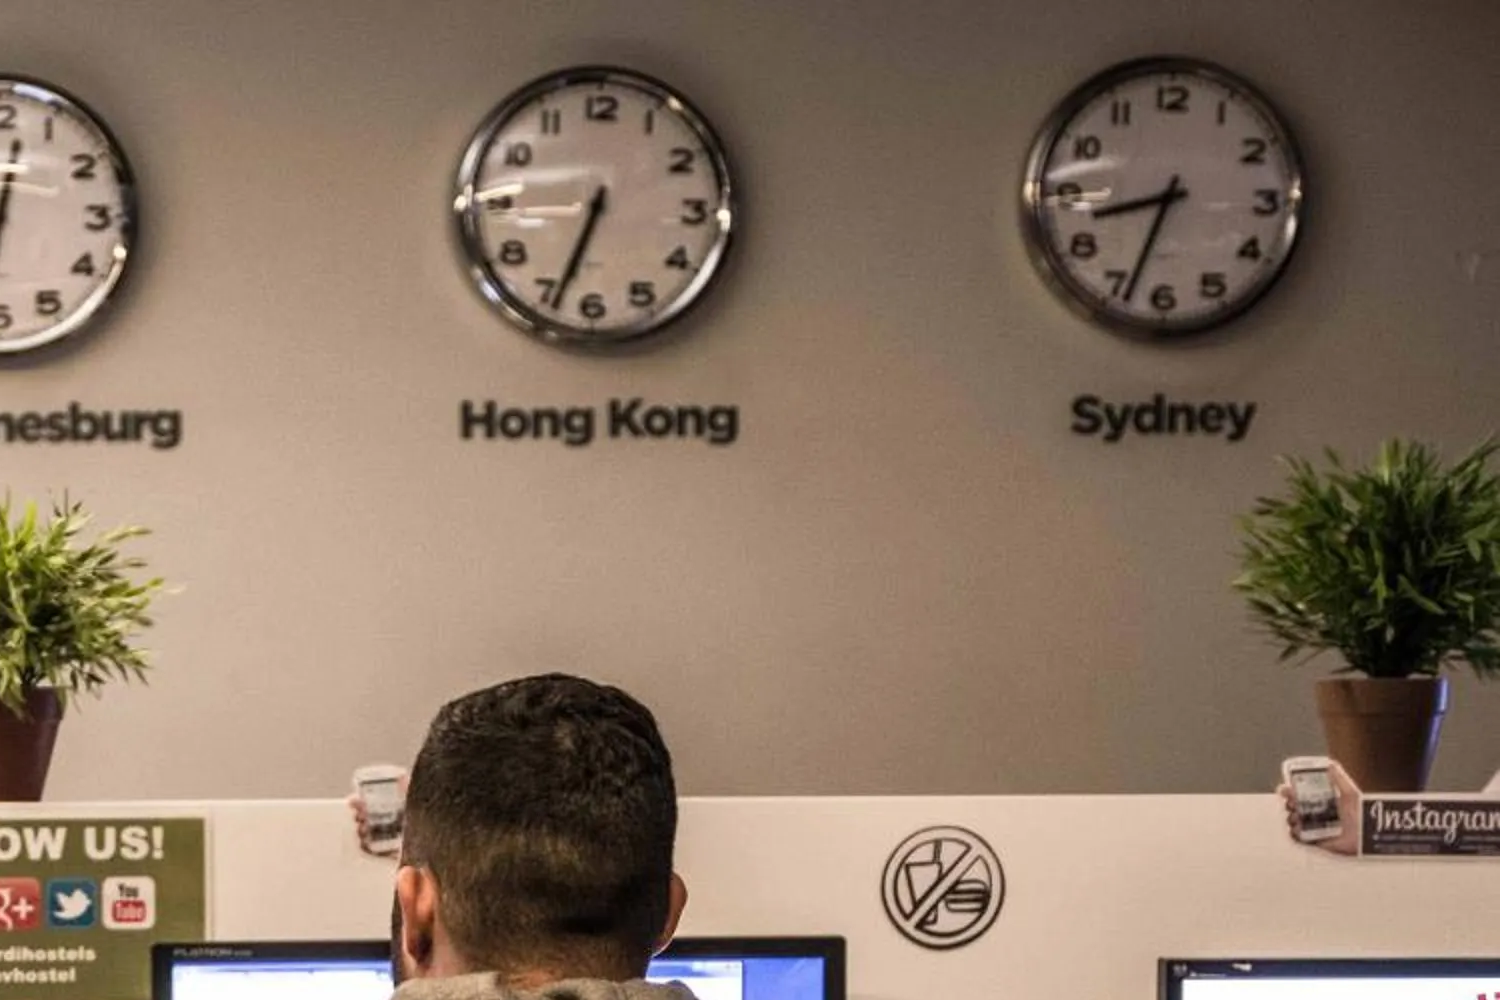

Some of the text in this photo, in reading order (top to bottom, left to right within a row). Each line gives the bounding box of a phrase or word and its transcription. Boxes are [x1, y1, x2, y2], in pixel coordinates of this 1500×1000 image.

[586, 96, 618, 121] 12
[1157, 87, 1189, 112] 12
[541, 110, 560, 134] 11
[645, 110, 653, 134] 1
[1111, 101, 1130, 125] 11
[1217, 101, 1225, 125] 1
[44, 117, 53, 141] 1
[506, 143, 532, 166] 10
[1075, 136, 1101, 159] 10
[1240, 139, 1266, 163] 2
[71, 154, 95, 178] 2
[669, 149, 693, 173] 2
[682, 199, 707, 224] 3
[1253, 190, 1278, 215] 3
[85, 206, 110, 230] 3
[501, 240, 527, 265] 8
[1071, 233, 1097, 258] 8
[1237, 237, 1259, 261] 4
[71, 252, 94, 276] 4
[665, 246, 688, 270] 4
[536, 279, 555, 303] 7
[629, 282, 655, 306] 5
[1105, 271, 1125, 296] 7
[1201, 273, 1226, 298] 5
[36, 290, 61, 314] 5
[580, 294, 606, 319] 6
[1152, 285, 1177, 310] 6
[459, 398, 739, 446] Hong Kong
[1071, 393, 1256, 442] Sydney
[83, 826, 165, 860] US!
